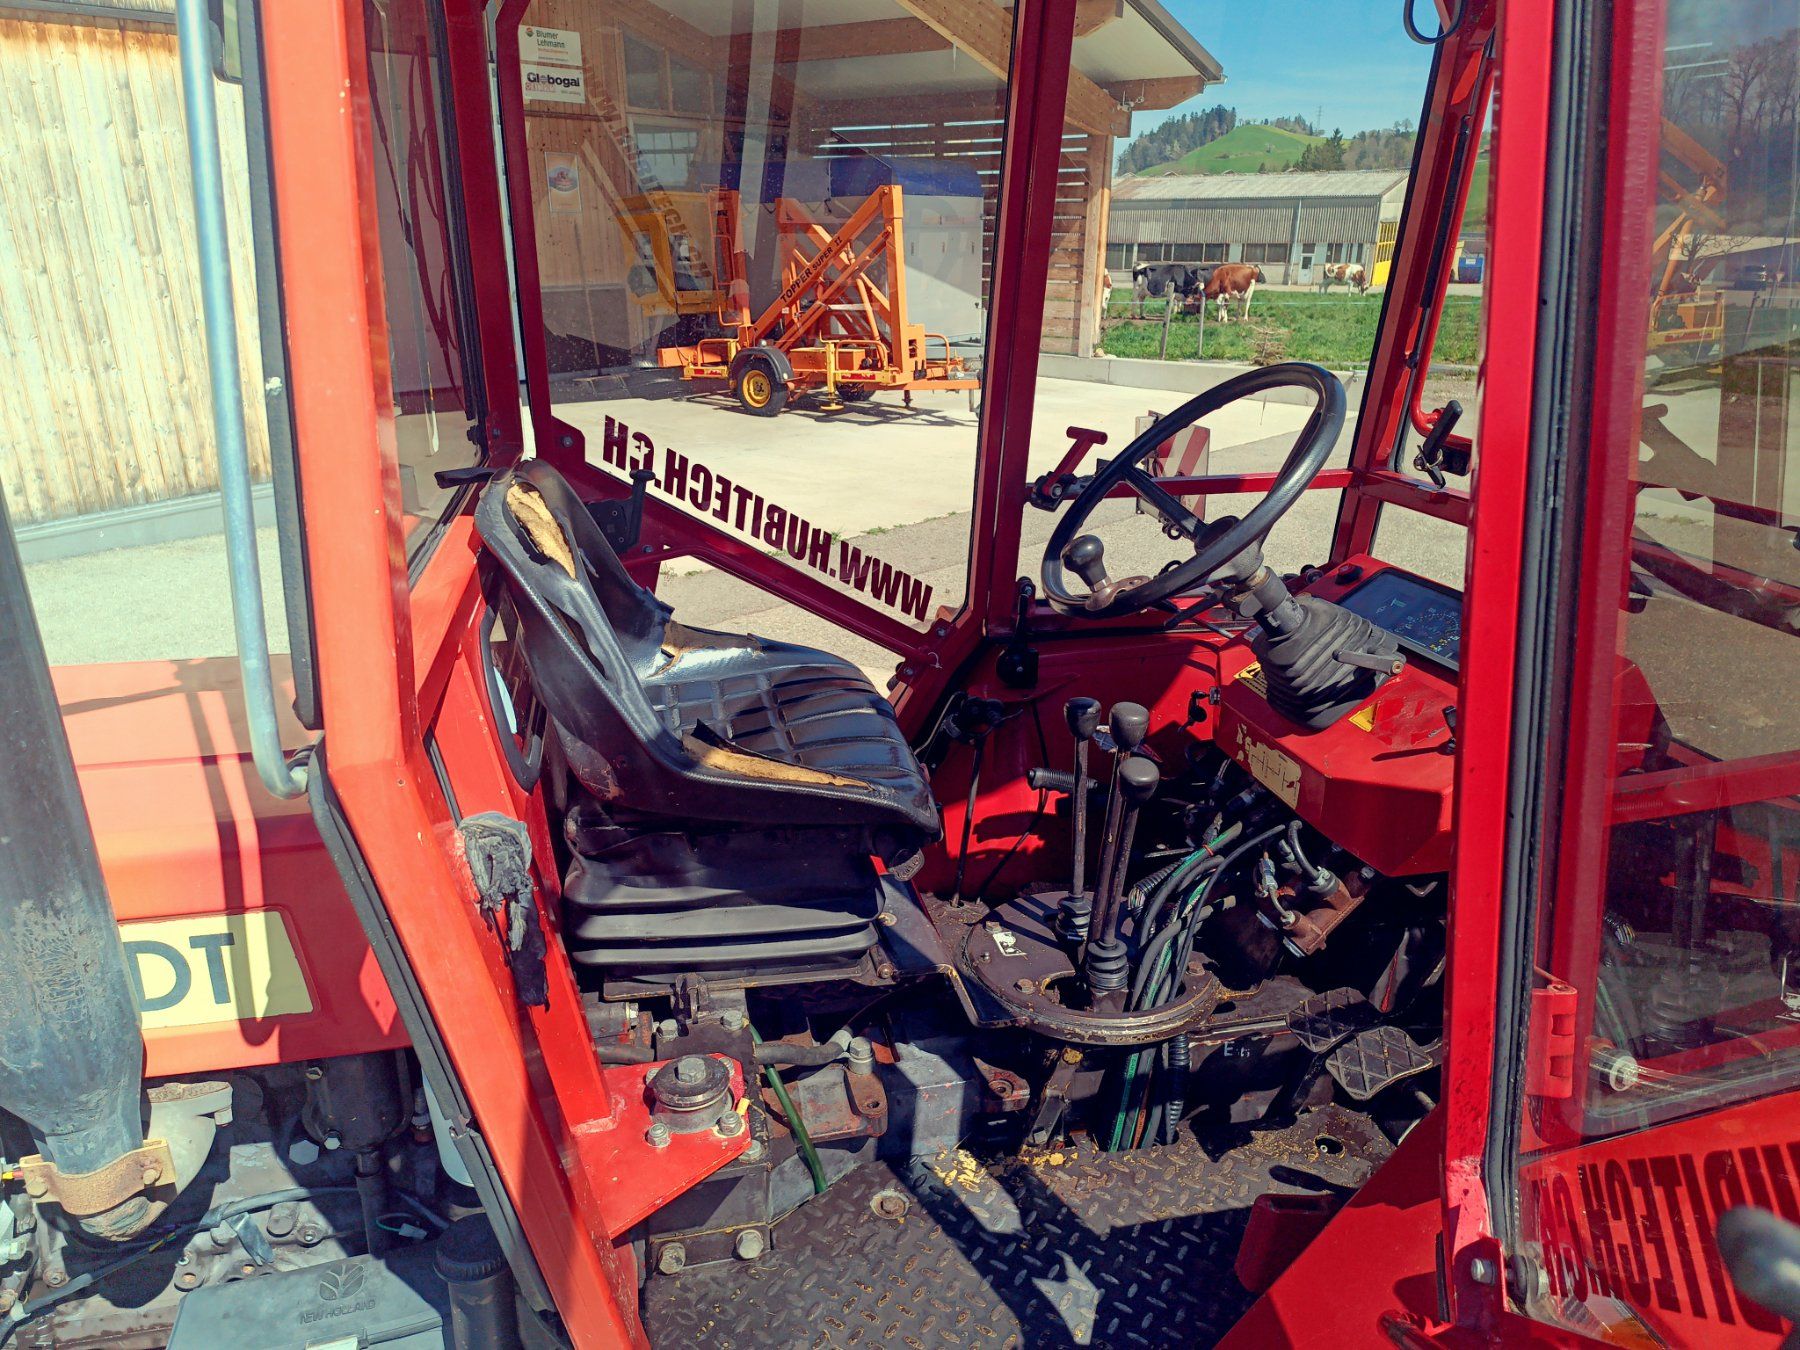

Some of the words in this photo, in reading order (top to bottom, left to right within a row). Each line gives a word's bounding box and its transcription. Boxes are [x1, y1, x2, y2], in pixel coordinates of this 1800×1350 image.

[536, 29, 559, 39] Blumer
[537, 39, 566, 49] Lehmann
[527, 72, 581, 88] Globogal
[780, 268, 813, 303] TOPPER
[812, 247, 834, 271] SUPER
[299, 1309, 324, 1325] NEW
[325, 1298, 377, 1319] HOLLAND
